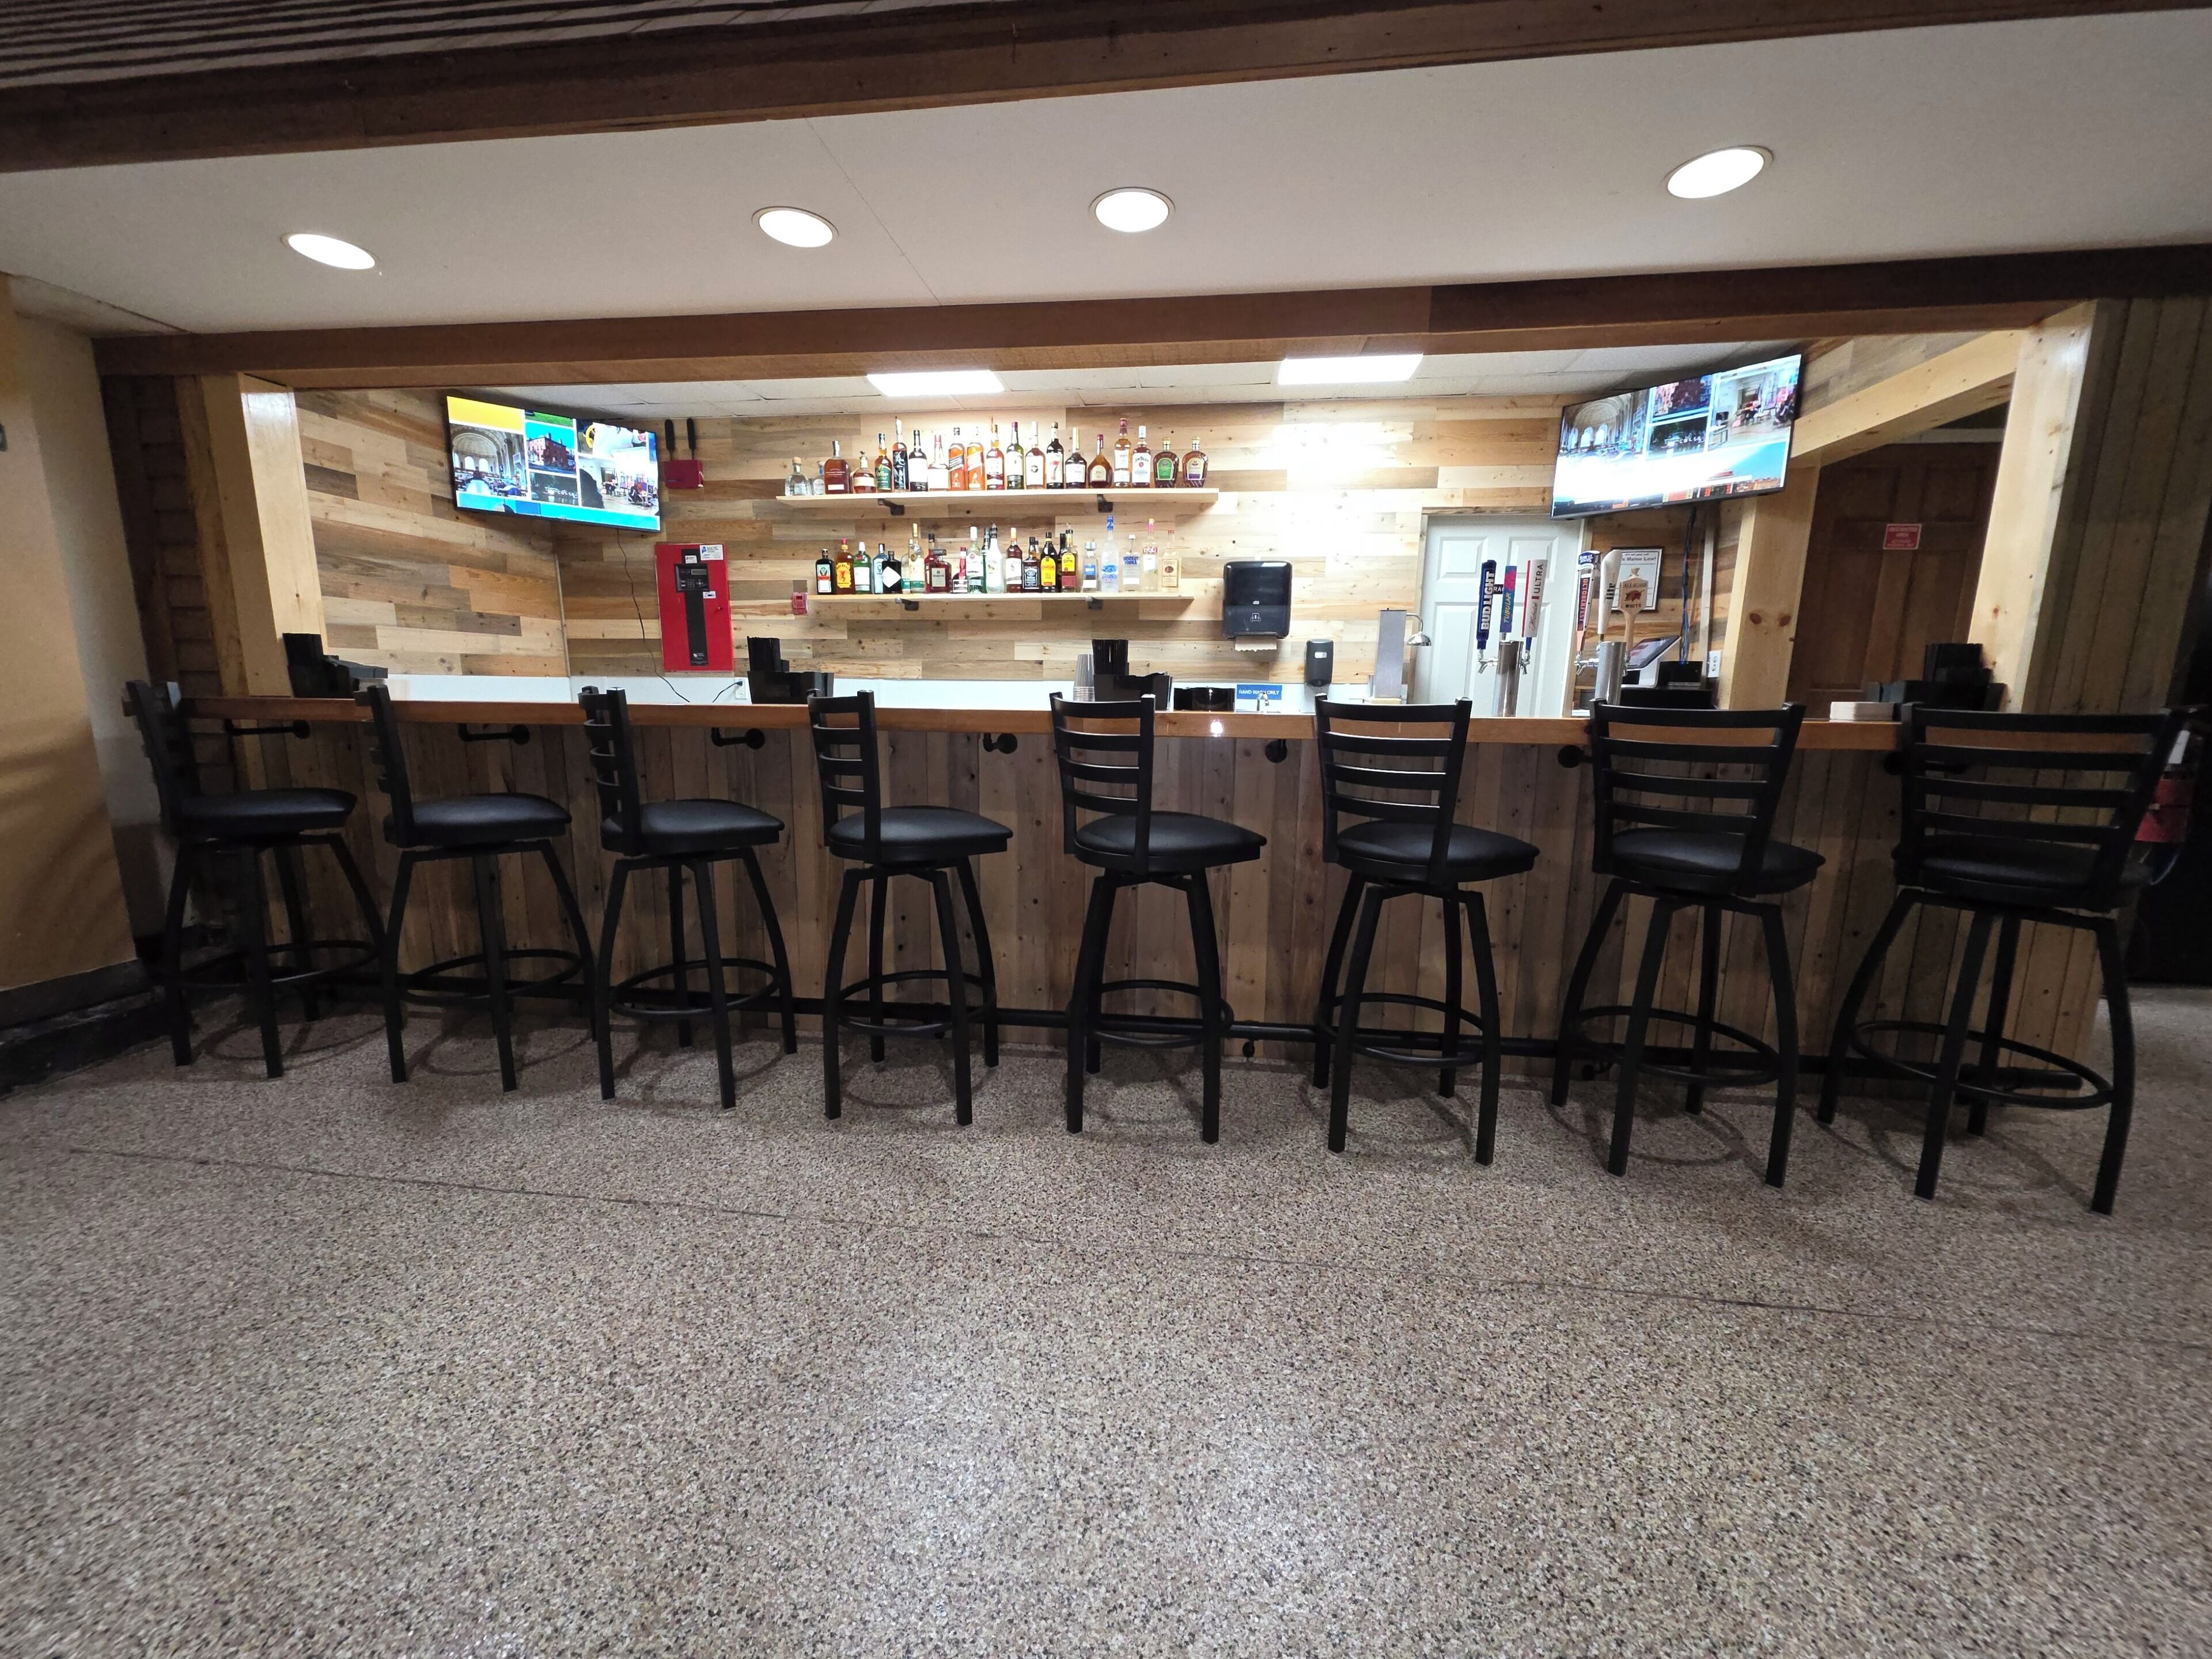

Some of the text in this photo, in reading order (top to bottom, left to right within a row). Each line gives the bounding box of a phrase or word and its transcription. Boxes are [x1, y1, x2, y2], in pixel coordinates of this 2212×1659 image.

[1050, 461, 1060, 480] 7
[1534, 564, 1543, 593] ULTRA
[1481, 571, 1494, 630] BUD LIGHT
[1503, 592, 1512, 623] TUBULAR
